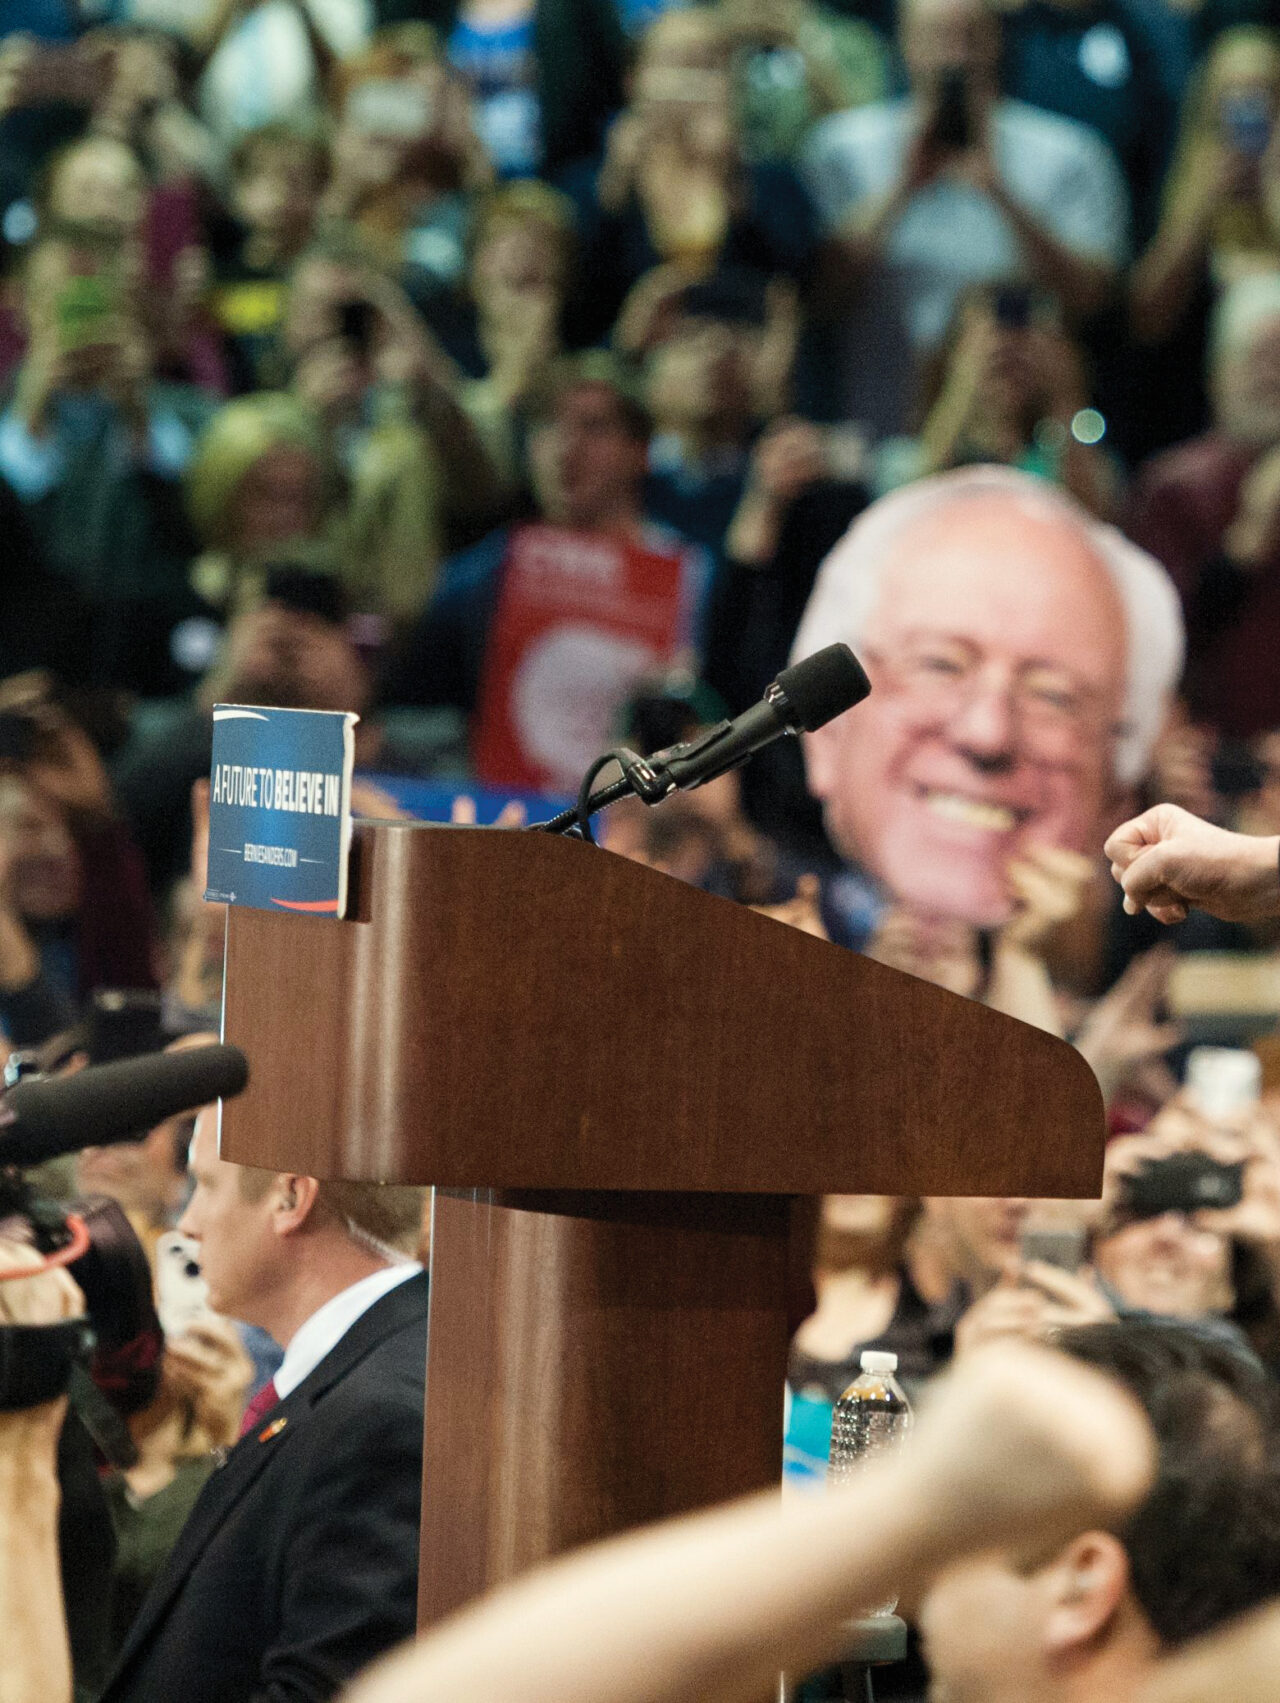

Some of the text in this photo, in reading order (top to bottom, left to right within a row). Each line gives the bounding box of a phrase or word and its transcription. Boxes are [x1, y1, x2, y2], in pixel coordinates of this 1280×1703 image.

[213, 764, 340, 816] A FUTURE TO BELIEVE IN
[244, 843, 297, 867] BERNIESANDERS.COM
